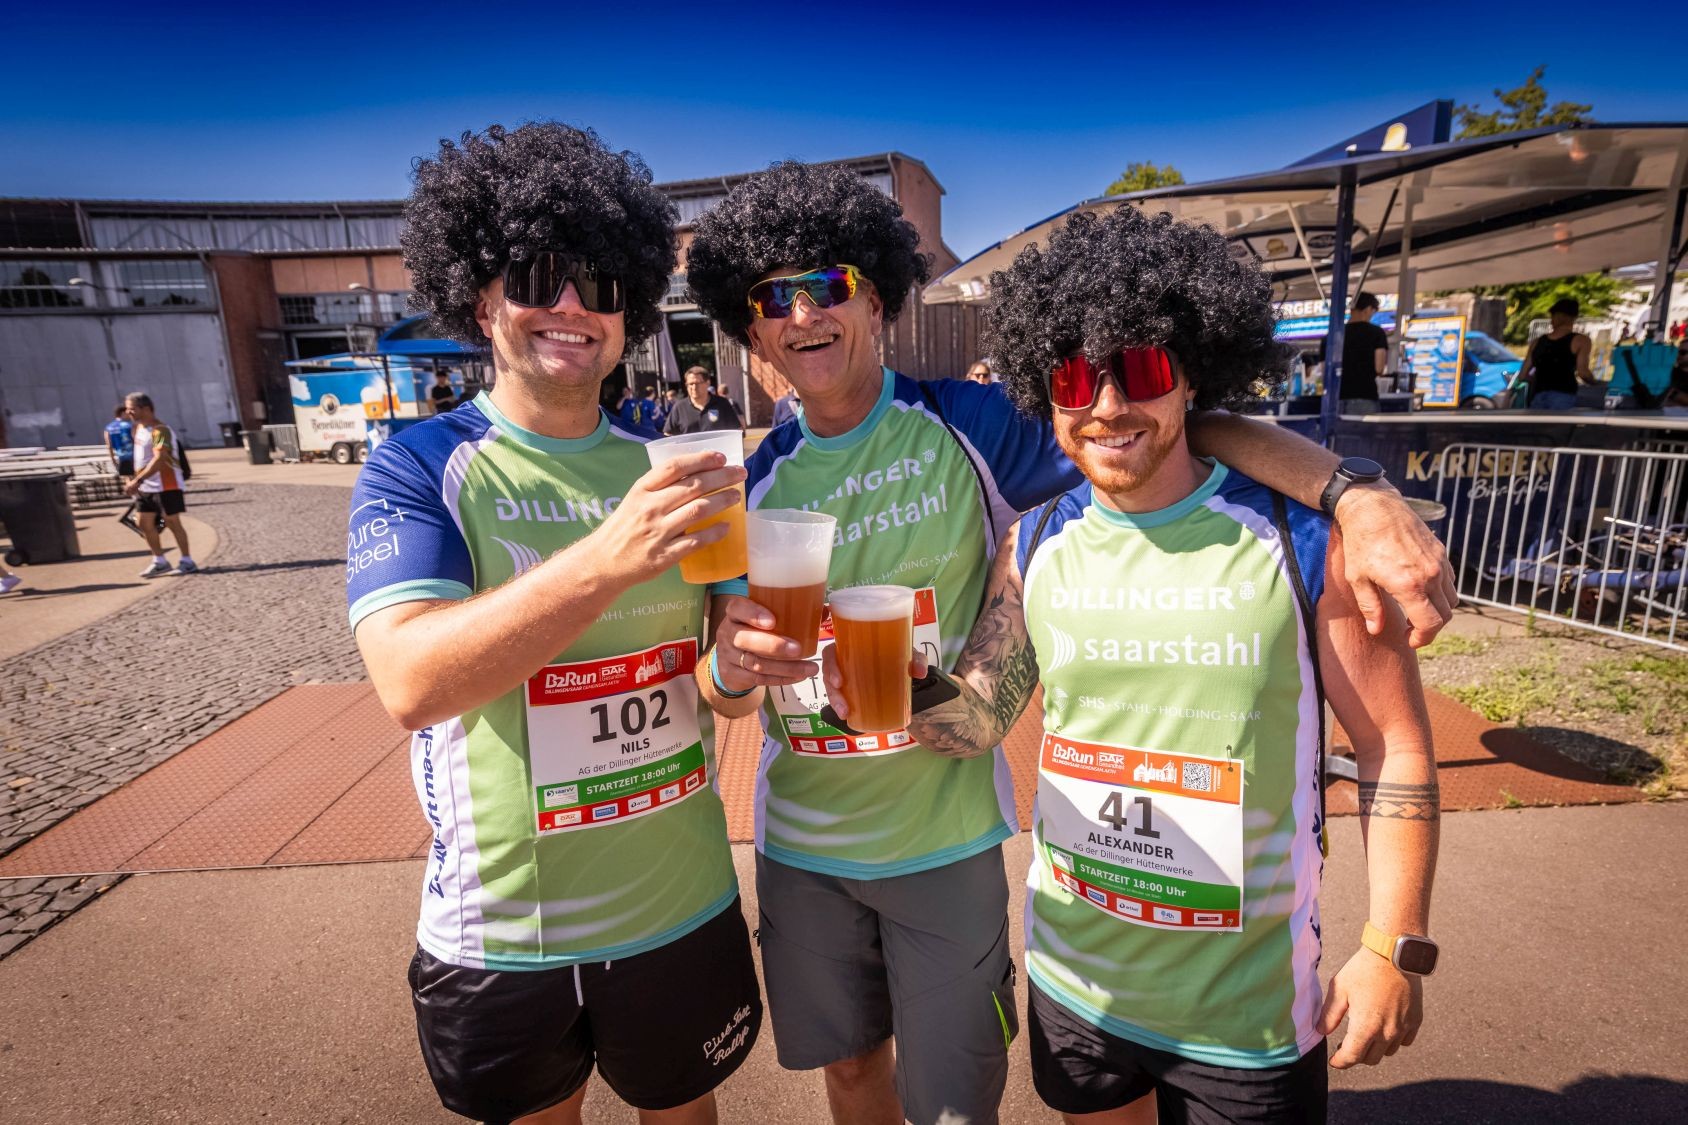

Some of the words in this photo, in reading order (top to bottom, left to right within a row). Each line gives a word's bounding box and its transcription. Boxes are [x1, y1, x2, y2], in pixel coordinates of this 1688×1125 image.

[832, 483, 948, 547] aarstahl
[346, 533, 399, 584] Steel
[1050, 586, 1236, 611] DILLINGER
[1084, 632, 1261, 666] saarstahl
[545, 671, 597, 689] B2Run
[601, 664, 626, 676] DAK
[590, 689, 671, 744] 102
[578, 766, 591, 776] AG
[593, 763, 607, 772] der
[609, 752, 642, 770] Dillinger
[643, 741, 683, 760] Hüttenwerke
[621, 737, 650, 755] NILS
[1052, 743, 1094, 765] B2Run
[1099, 751, 1125, 764] DAK
[586, 775, 639, 795] STARTZEIT
[642, 767, 666, 782] 18:00
[667, 761, 681, 773] Uhr
[1098, 791, 1160, 839] 41
[1073, 842, 1084, 852] AG
[1086, 844, 1099, 856] der
[1100, 849, 1134, 865] Dillinger
[1136, 858, 1193, 876] Hüttenwerke
[1088, 831, 1174, 860] ALEXANDER
[1080, 863, 1130, 886] STARTZEIT
[1133, 878, 1163, 893] 18:00
[1166, 886, 1187, 897] Uhr
